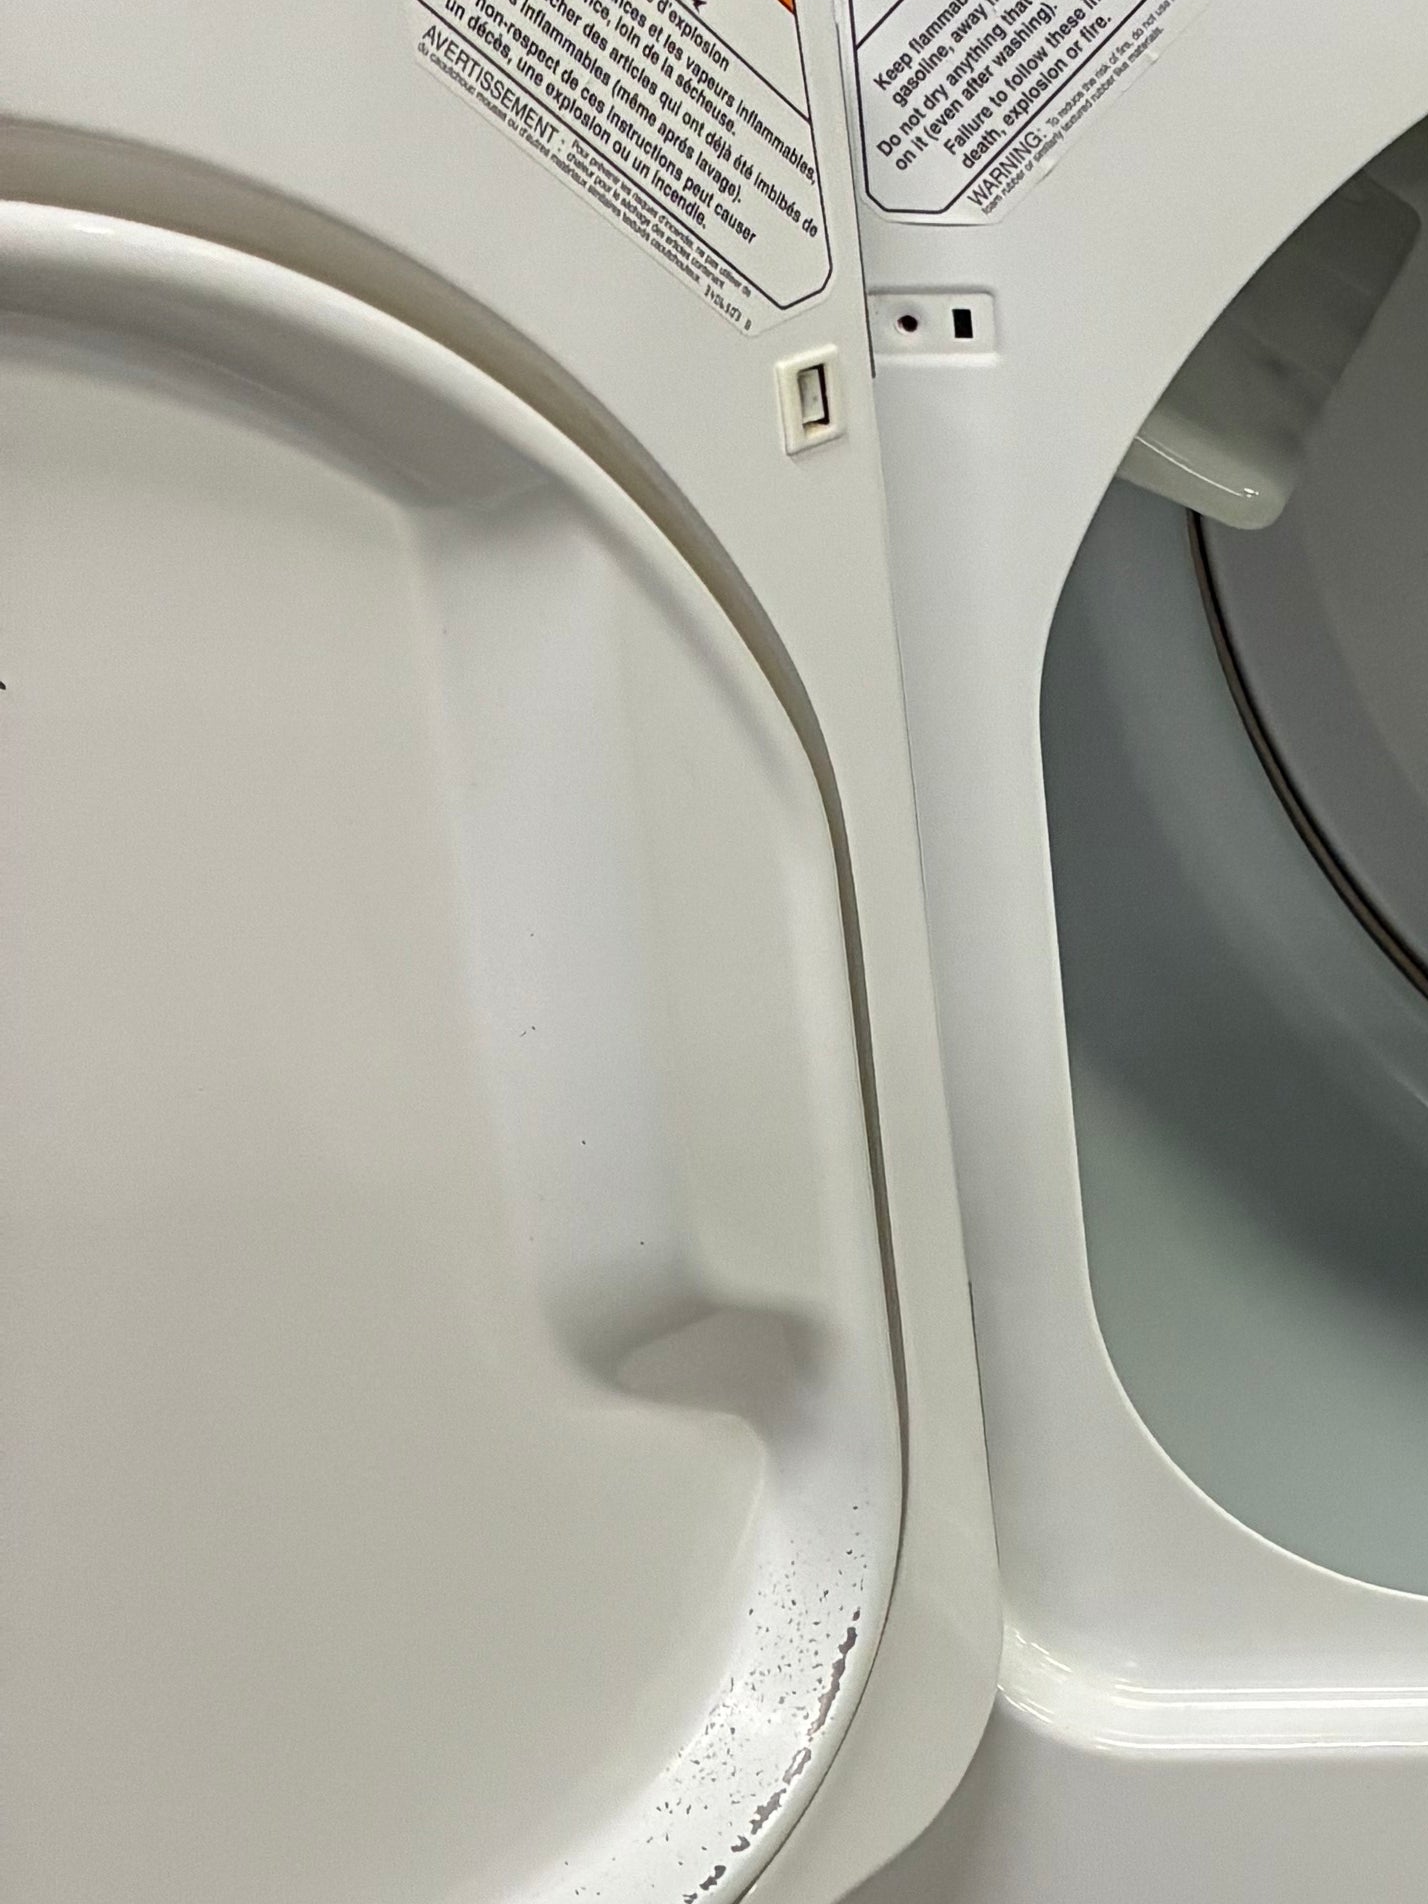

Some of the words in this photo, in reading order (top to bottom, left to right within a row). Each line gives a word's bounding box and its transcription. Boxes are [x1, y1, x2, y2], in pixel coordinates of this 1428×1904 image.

[648, 23, 664, 47] et
[662, 33, 684, 62] les
[686, 55, 736, 108] vapeurs
[735, 99, 821, 186] inflammables,
[872, 52, 913, 91] Keep
[876, 134, 902, 157] Do
[899, 107, 927, 136] not
[923, 83, 949, 111] dry
[945, 23, 1008, 87] anything
[892, 45, 955, 108] gasoline,
[950, 3, 989, 44] away
[895, 149, 917, 171] on
[910, 136, 929, 152] it
[923, 99, 964, 142] (even
[961, 64, 994, 102] after
[991, 2, 1058, 67] washing).
[943, 106, 994, 156] Failure
[988, 90, 1008, 108] to
[1003, 45, 1049, 92] follow
[1044, 8, 1086, 49] these
[962, 128, 1007, 169] death,
[1002, 58, 1069, 127] explosion
[1065, 39, 1083, 60] or
[1079, 16, 1112, 43] fire.
[966, 128, 1047, 207] WARNING:
